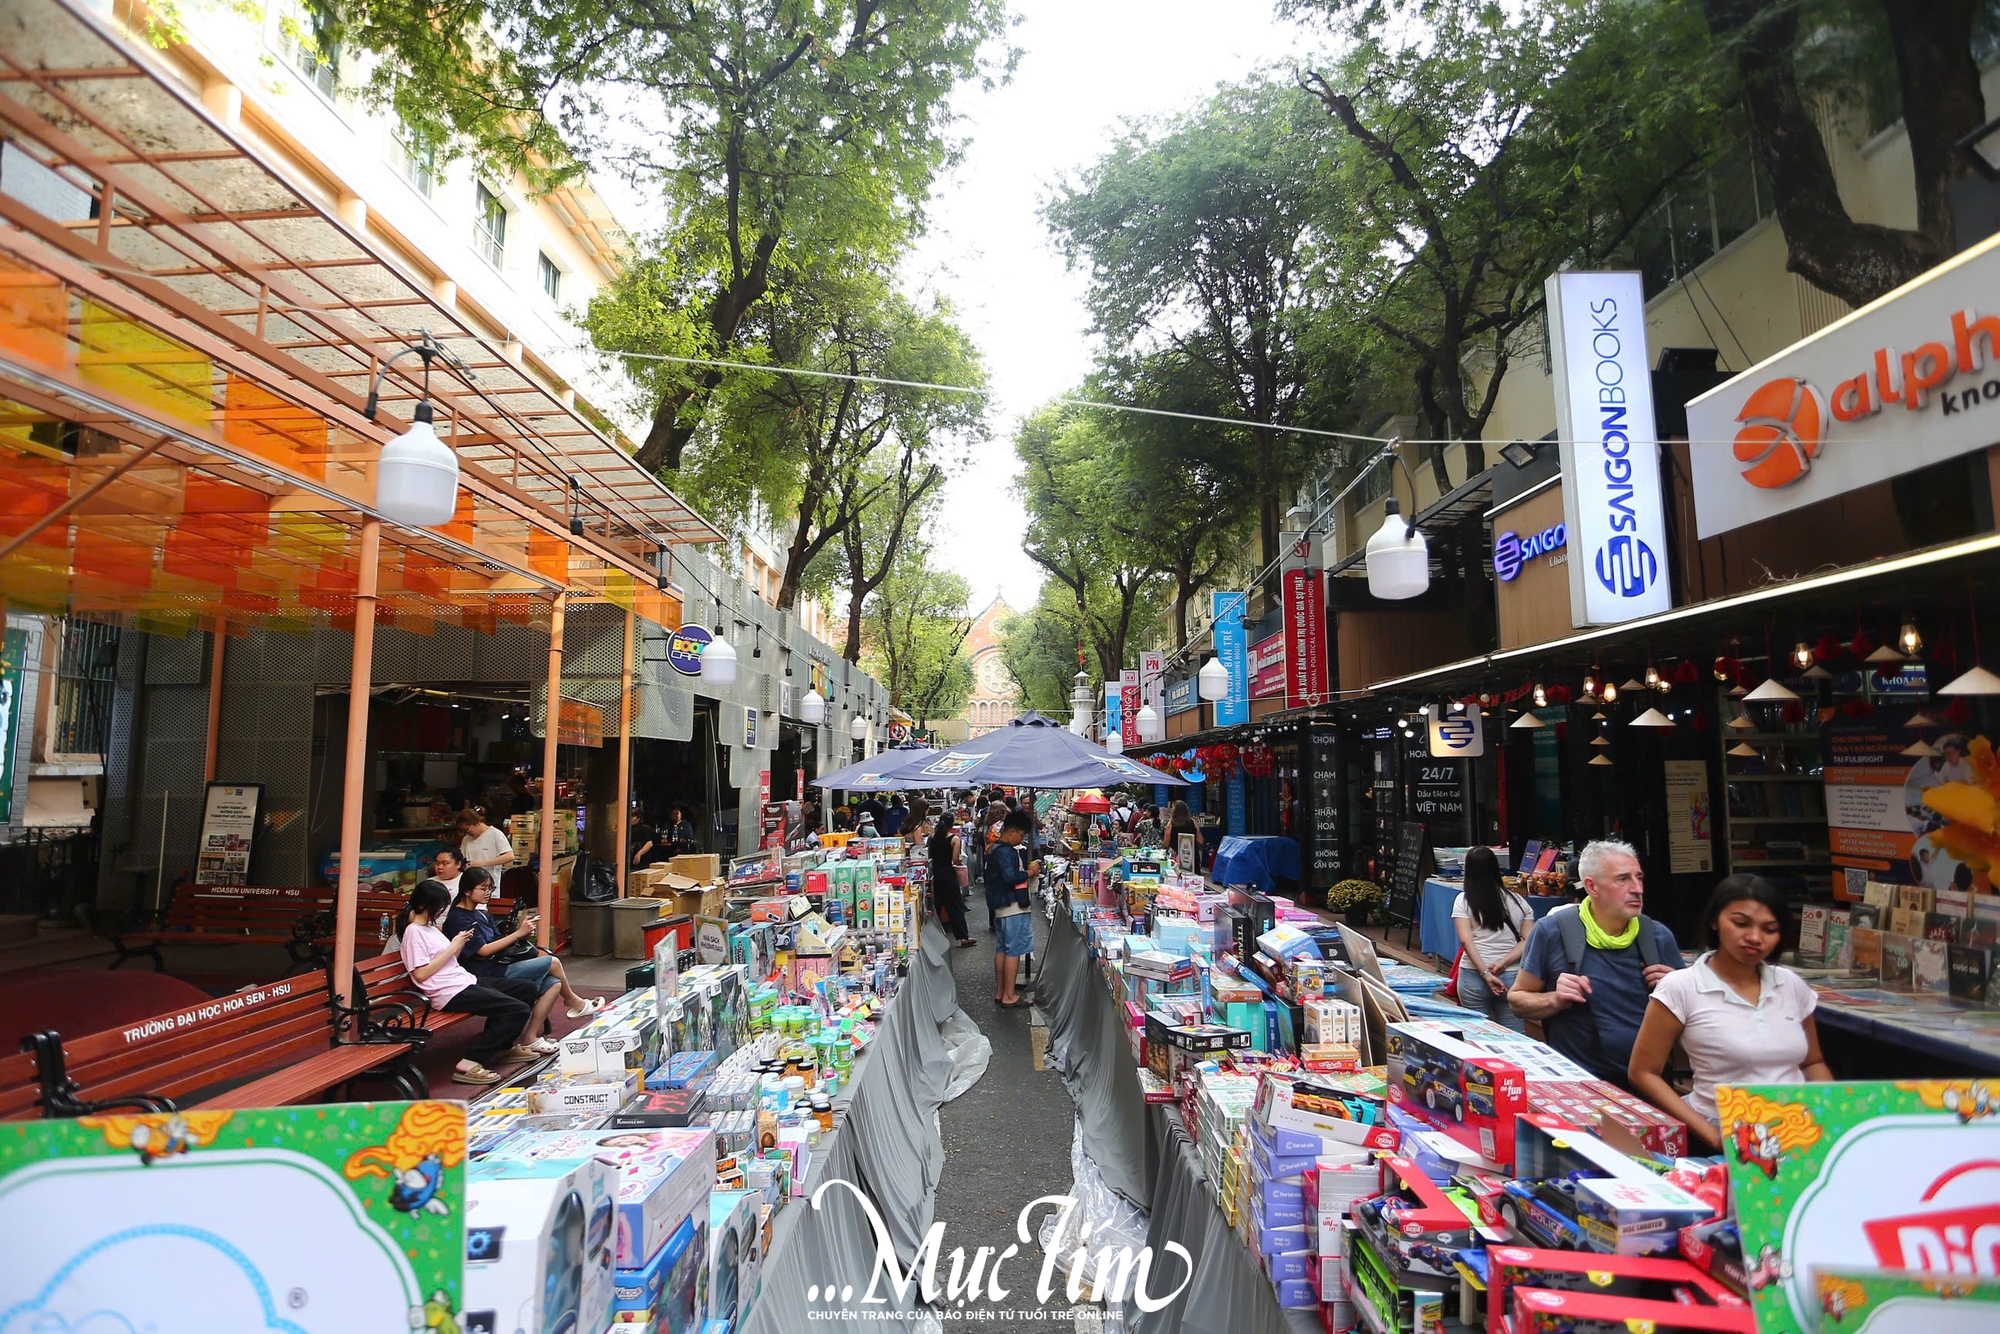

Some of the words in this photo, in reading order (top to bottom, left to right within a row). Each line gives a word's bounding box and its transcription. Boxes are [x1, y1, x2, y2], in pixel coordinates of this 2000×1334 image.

[1592, 297, 1636, 533] SAIGONBOOKS
[1295, 600, 1304, 611] GIA
[1308, 599, 1316, 636] PUBLISHING
[1220, 629, 1232, 646] TRẺ
[1233, 642, 1241, 660] HOUSE
[1308, 636, 1317, 668] POLITICAL
[1221, 649, 1233, 667] BẢN
[1295, 658, 1307, 671] BẢN
[1123, 697, 1133, 724] ĐÔNG
[1125, 726, 1133, 745] SÁCH
[1312, 735, 1336, 746] CHỌN
[1409, 750, 1428, 759] HOA
[1832, 755, 1844, 765] TẠI
[1845, 754, 1884, 763] FULBRIGHT
[1313, 771, 1336, 781] CHẠM
[1421, 767, 1455, 780] 24/7
[1314, 806, 1338, 818] NHẬN
[1416, 800, 1437, 815] VIỆT
[1440, 802, 1463, 813] NAM
[1317, 822, 1336, 831] HOA
[1315, 848, 1339, 858] KHÔNG
[240, 888, 280, 896] UNIVERSITY
[285, 889, 300, 897] HSU
[123, 1016, 174, 1043] TRƯỜNG
[176, 1012, 197, 1029] ĐẠI
[198, 1003, 222, 1022] HỌC
[223, 996, 245, 1014] HOA
[246, 990, 266, 1007] SEN
[272, 983, 292, 999] HSU
[1503, 1077, 1514, 1087] Let
[1507, 1085, 1522, 1098] fun
[563, 1093, 609, 1105] CONSTRUCT
[1529, 1206, 1561, 1237] POLICE
[1622, 1223, 1636, 1234] DISC
[1636, 1220, 1663, 1232] SHOOTER
